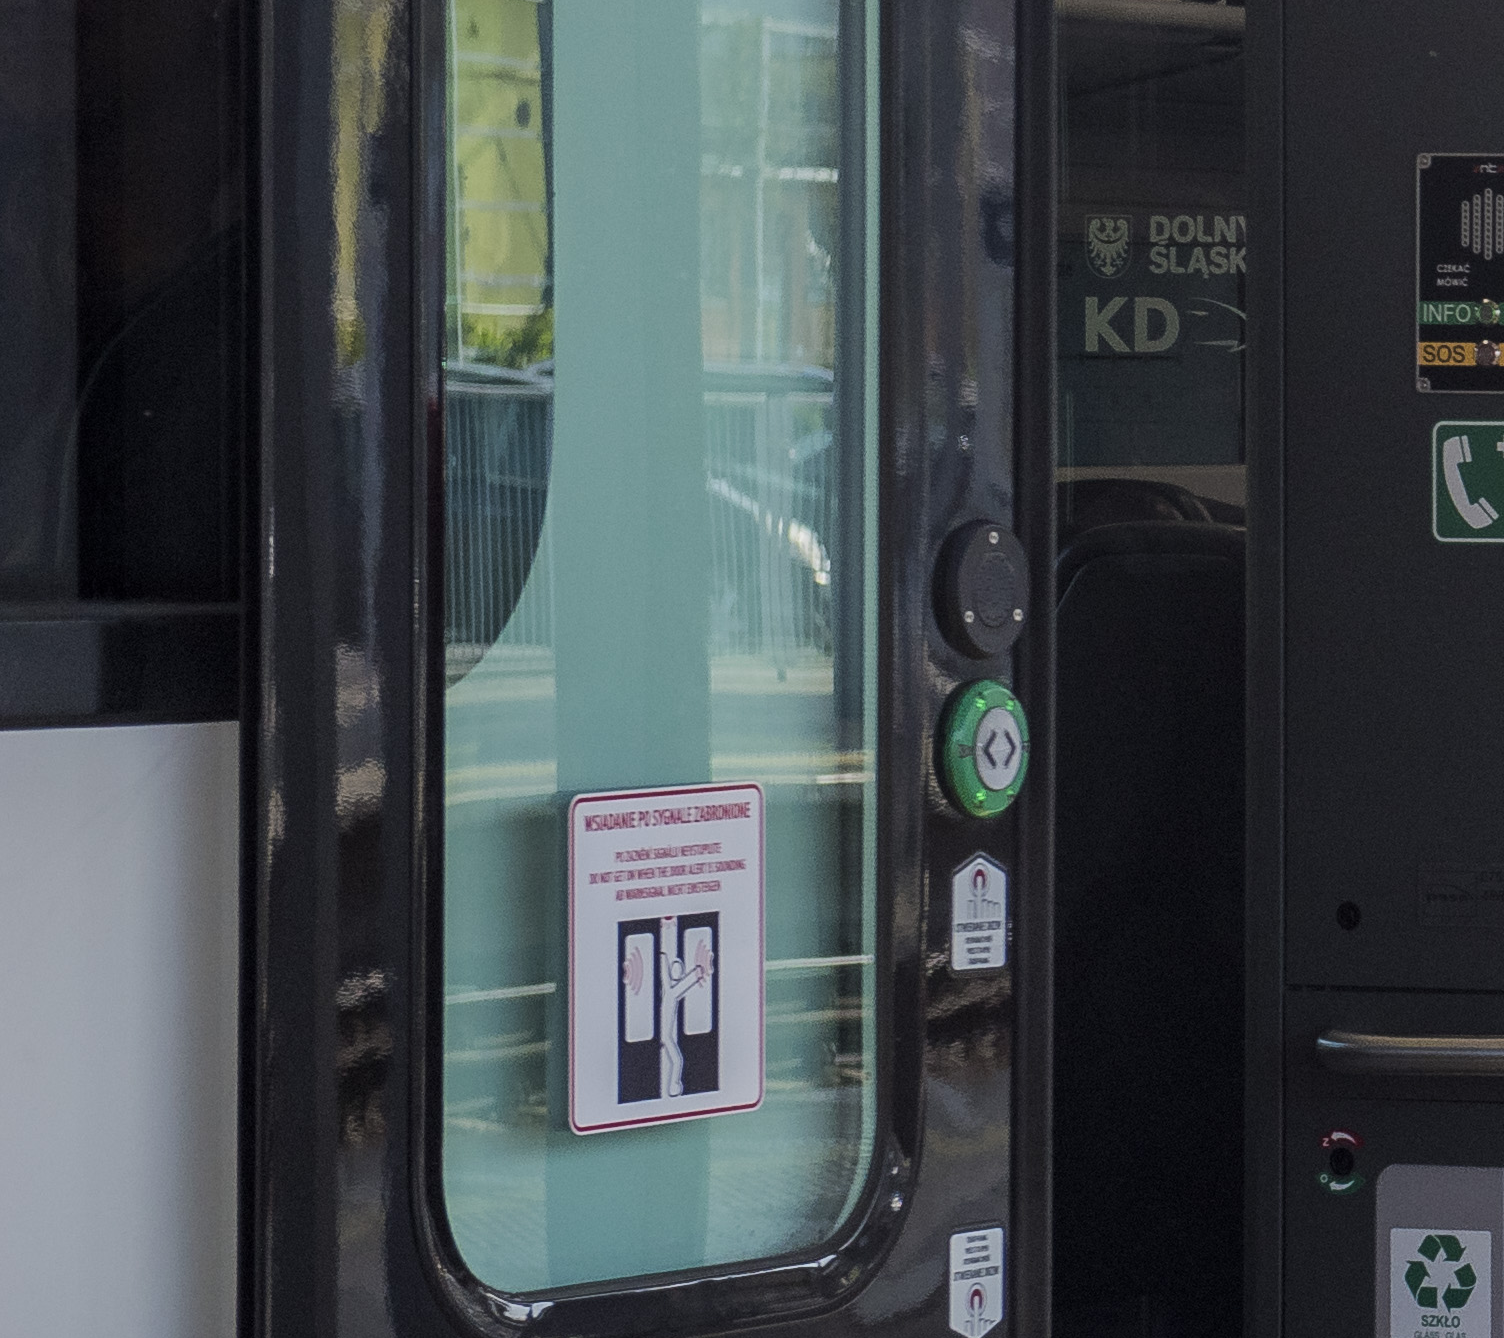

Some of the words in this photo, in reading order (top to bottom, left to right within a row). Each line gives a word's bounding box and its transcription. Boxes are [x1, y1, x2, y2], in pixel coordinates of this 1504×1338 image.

[1150, 241, 1247, 280] ŚLĄSK
[1436, 263, 1472, 274] CZEKAĆ
[1422, 303, 1473, 324] INFO
[1084, 296, 1181, 353] KD
[1422, 344, 1467, 364] SOS
[1322, 1137, 1330, 1147] Z
[1421, 1314, 1461, 1328] SZKŁO
